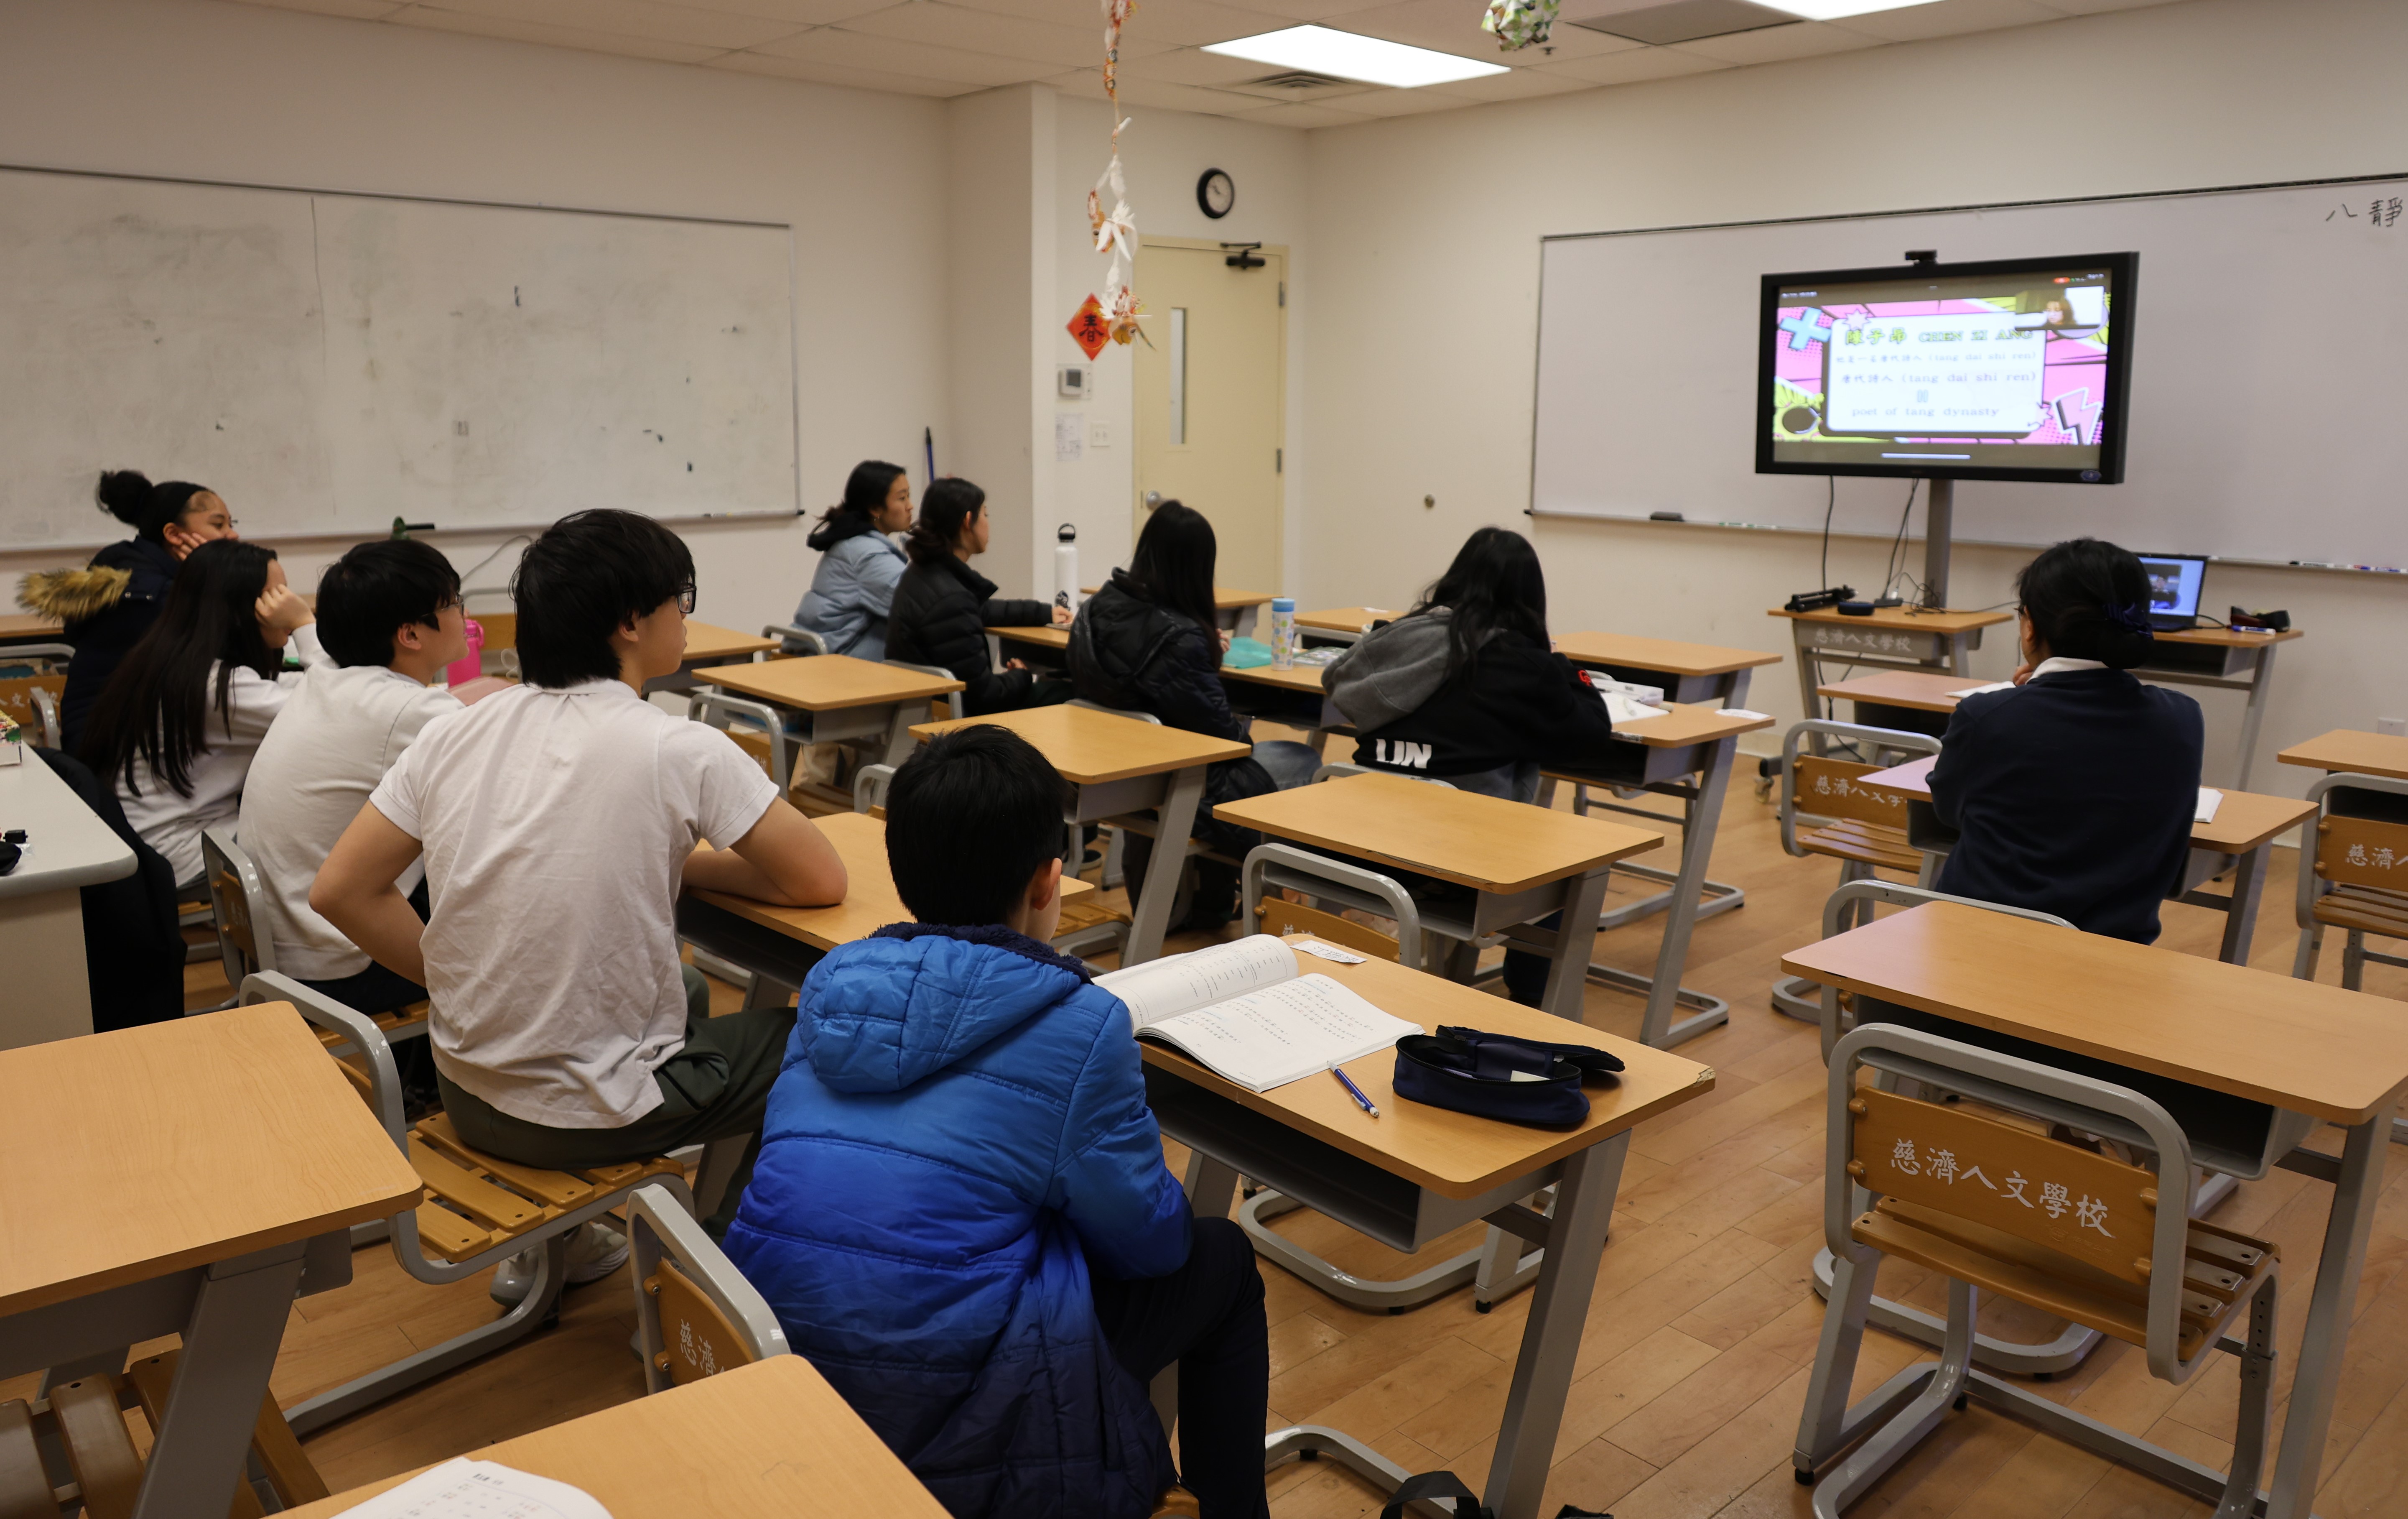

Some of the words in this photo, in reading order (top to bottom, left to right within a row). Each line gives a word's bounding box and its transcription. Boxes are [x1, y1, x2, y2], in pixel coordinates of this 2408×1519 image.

[1078, 314, 1104, 342] 春
[1919, 331, 1963, 342] CHEN
[1971, 329, 1988, 340] ZI
[1995, 329, 2033, 340] ANG
[1947, 373, 1967, 382] dai
[1976, 373, 1997, 381] shi
[1852, 408, 1878, 416] poet
[1885, 407, 1898, 416] of
[1906, 408, 1934, 417] tang
[1944, 407, 1999, 417] dynasty
[1891, 1138, 2116, 1238] 慈濟人文學校
[680, 1319, 725, 1376] 慈濟
